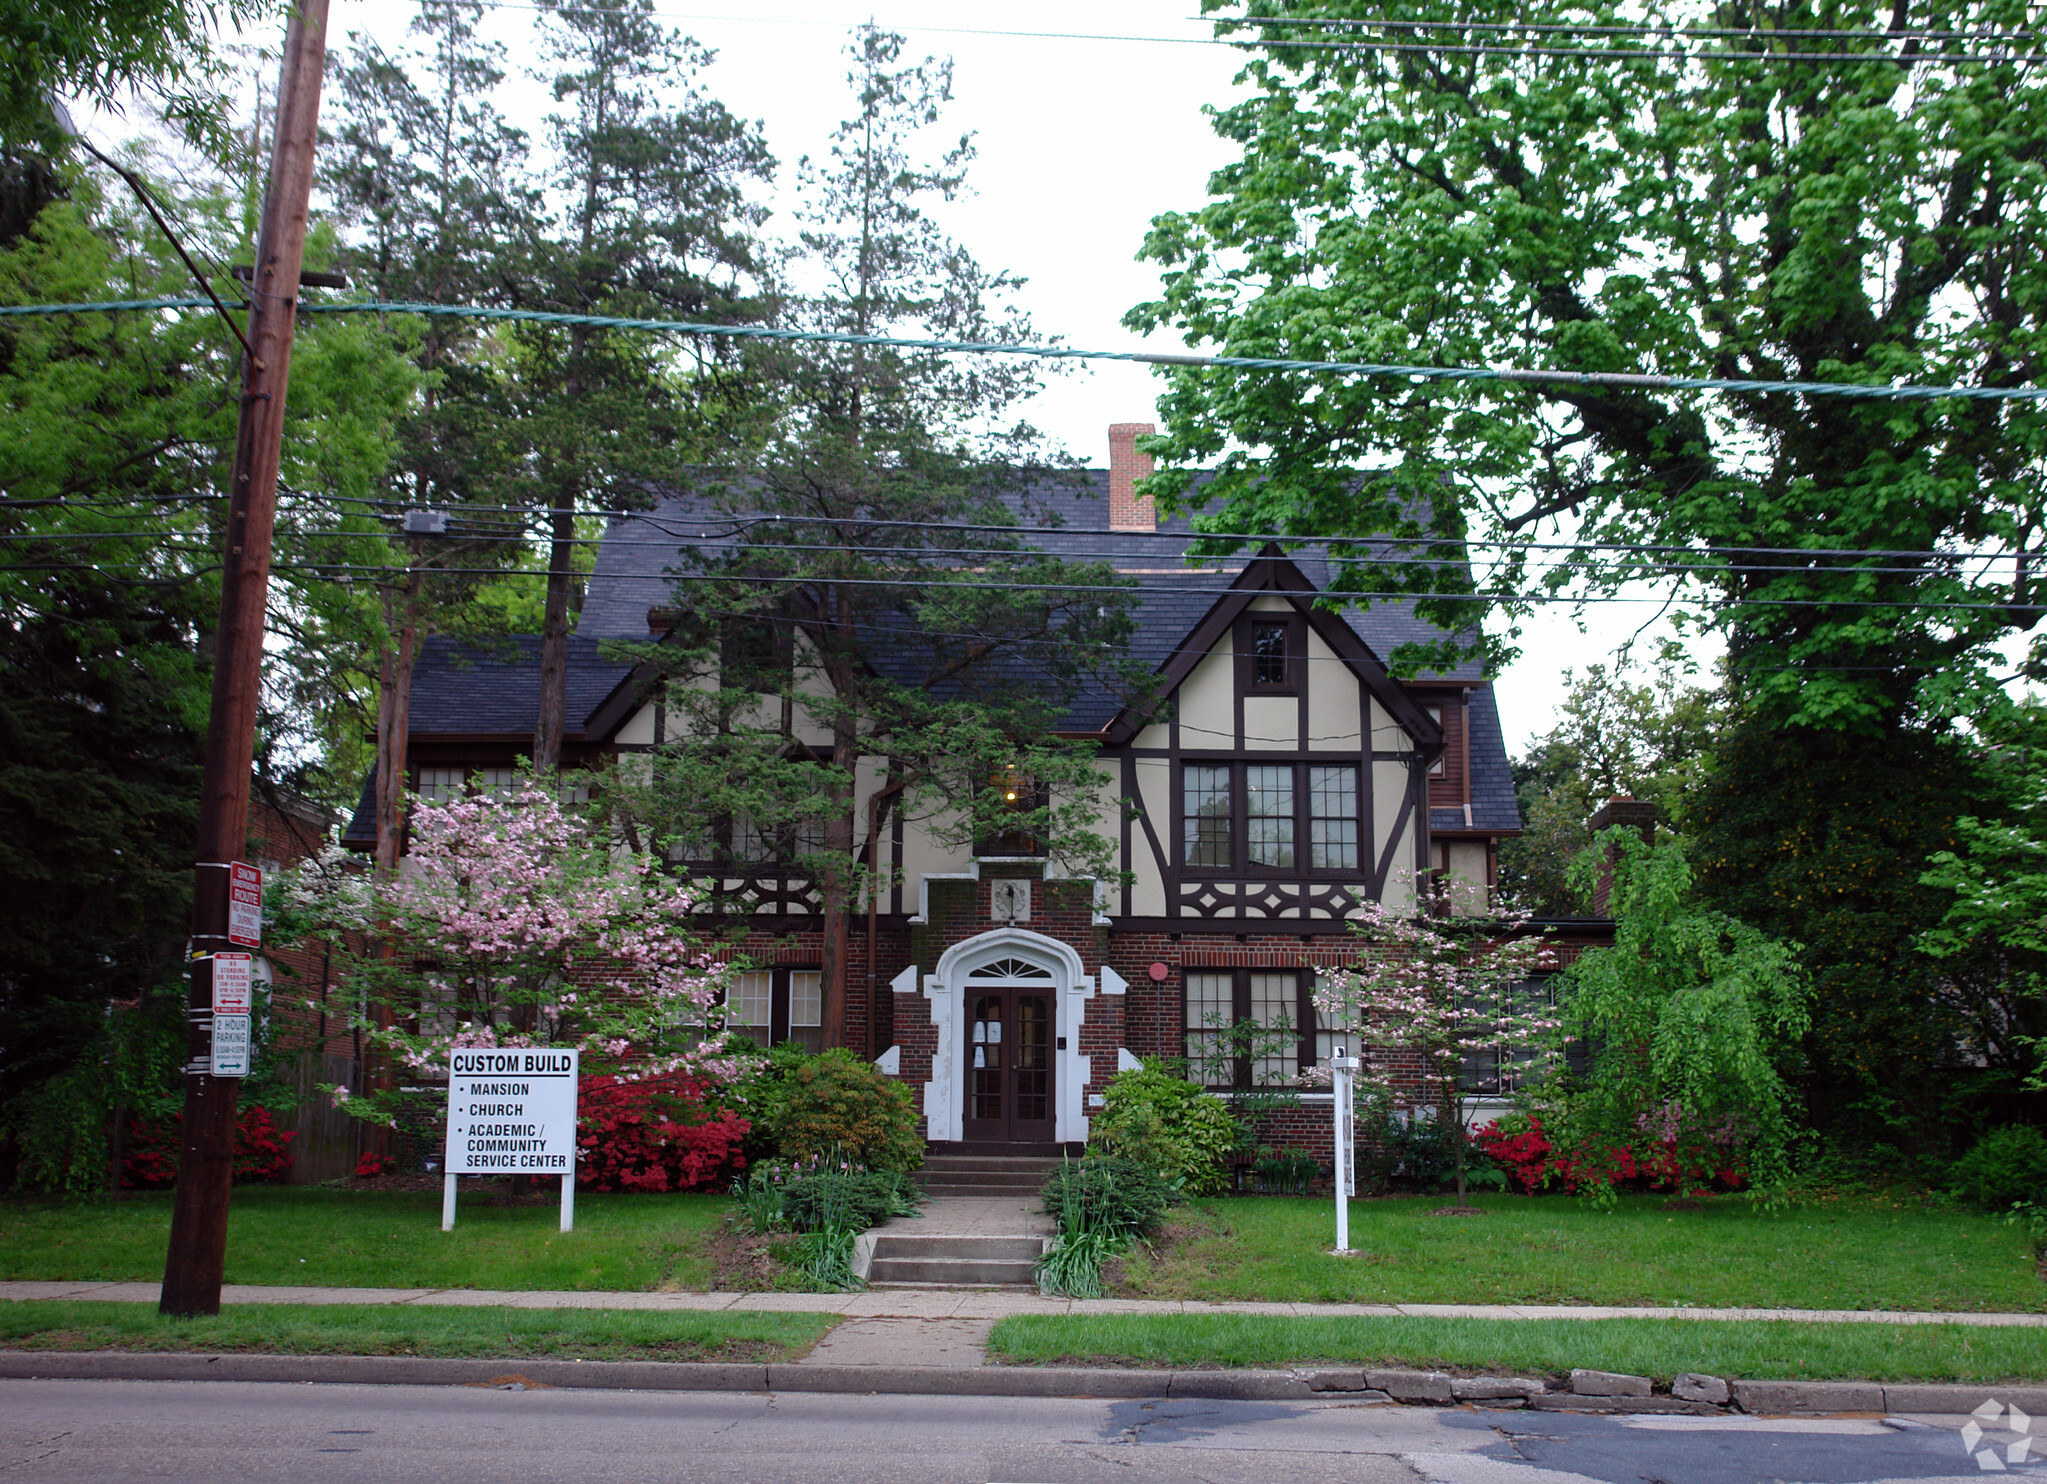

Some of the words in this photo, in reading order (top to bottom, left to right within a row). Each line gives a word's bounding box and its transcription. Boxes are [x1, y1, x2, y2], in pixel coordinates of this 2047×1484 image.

[238, 868, 256, 882] SNOW
[232, 878, 259, 891] EMERGENCY
[234, 888, 258, 904] ROUTE
[232, 902, 239, 912] NO
[241, 904, 259, 916] PARKING
[237, 914, 253, 926] DURING
[232, 924, 258, 938] EMERGENCY
[217, 1020, 221, 1030] 2
[224, 1019, 246, 1030] HOUR
[216, 1032, 245, 1042] PARKING
[454, 1055, 519, 1072] CUSTOM
[525, 1055, 571, 1072] BUILD
[471, 1084, 529, 1095] MANSION
[470, 1104, 523, 1116] CHURCH
[468, 1140, 547, 1152] COMMUNITY
[467, 1155, 517, 1167] SERVICE
[521, 1155, 566, 1167] CENTER
